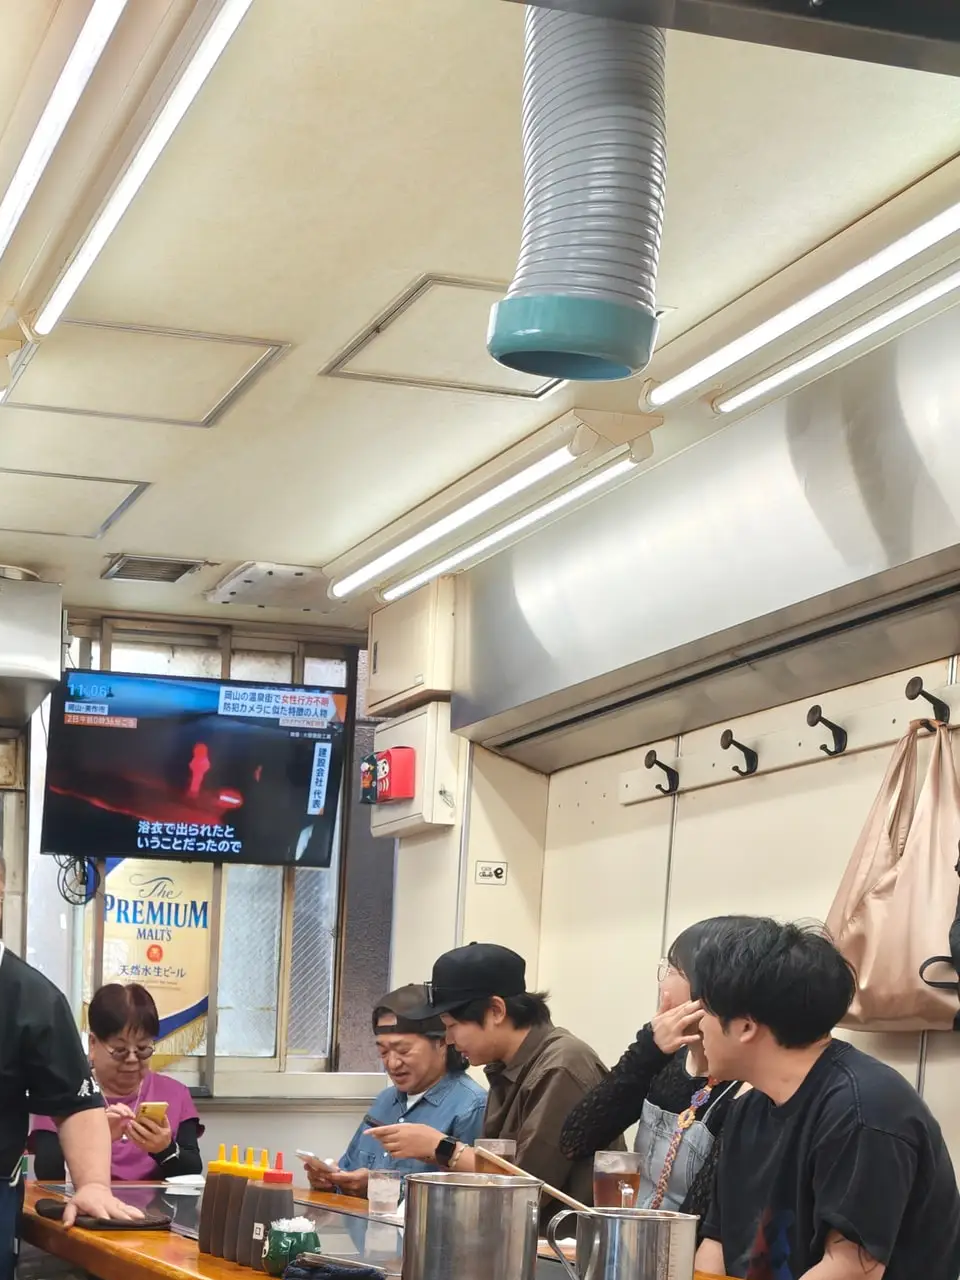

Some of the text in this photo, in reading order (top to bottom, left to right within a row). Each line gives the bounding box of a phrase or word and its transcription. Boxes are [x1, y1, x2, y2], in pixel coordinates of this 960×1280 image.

[223, 702, 328, 718] 防犯カメラに似た特徴の人物
[138, 821, 235, 836] 浴衣で出られたと
[137, 837, 242, 853] いうことだったので
[129, 874, 182, 899] The
[104, 893, 208, 928] PREMIUM
[119, 965, 186, 978] 天然水生ビール
